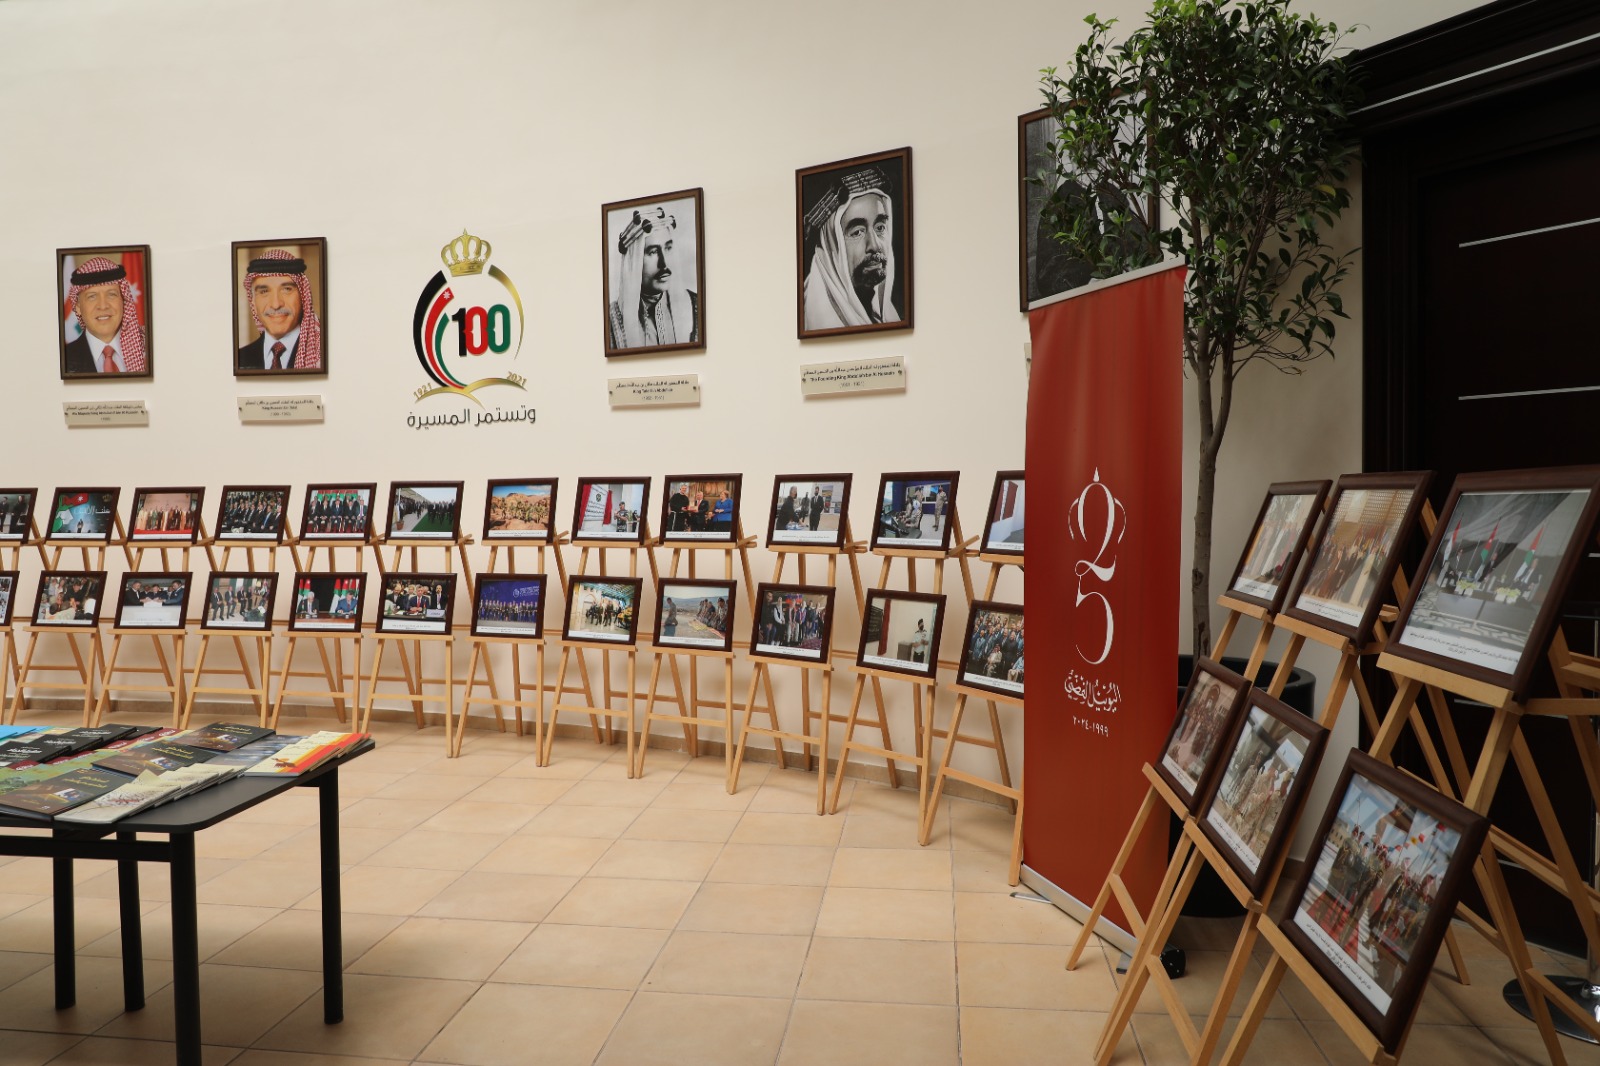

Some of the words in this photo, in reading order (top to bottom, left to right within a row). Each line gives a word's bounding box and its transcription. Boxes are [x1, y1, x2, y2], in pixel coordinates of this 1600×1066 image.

[452, 304, 511, 357] 100
[413, 382, 433, 400] 1921
[407, 408, 471, 430] المسيرة
[474, 405, 536, 427] وتستمر
